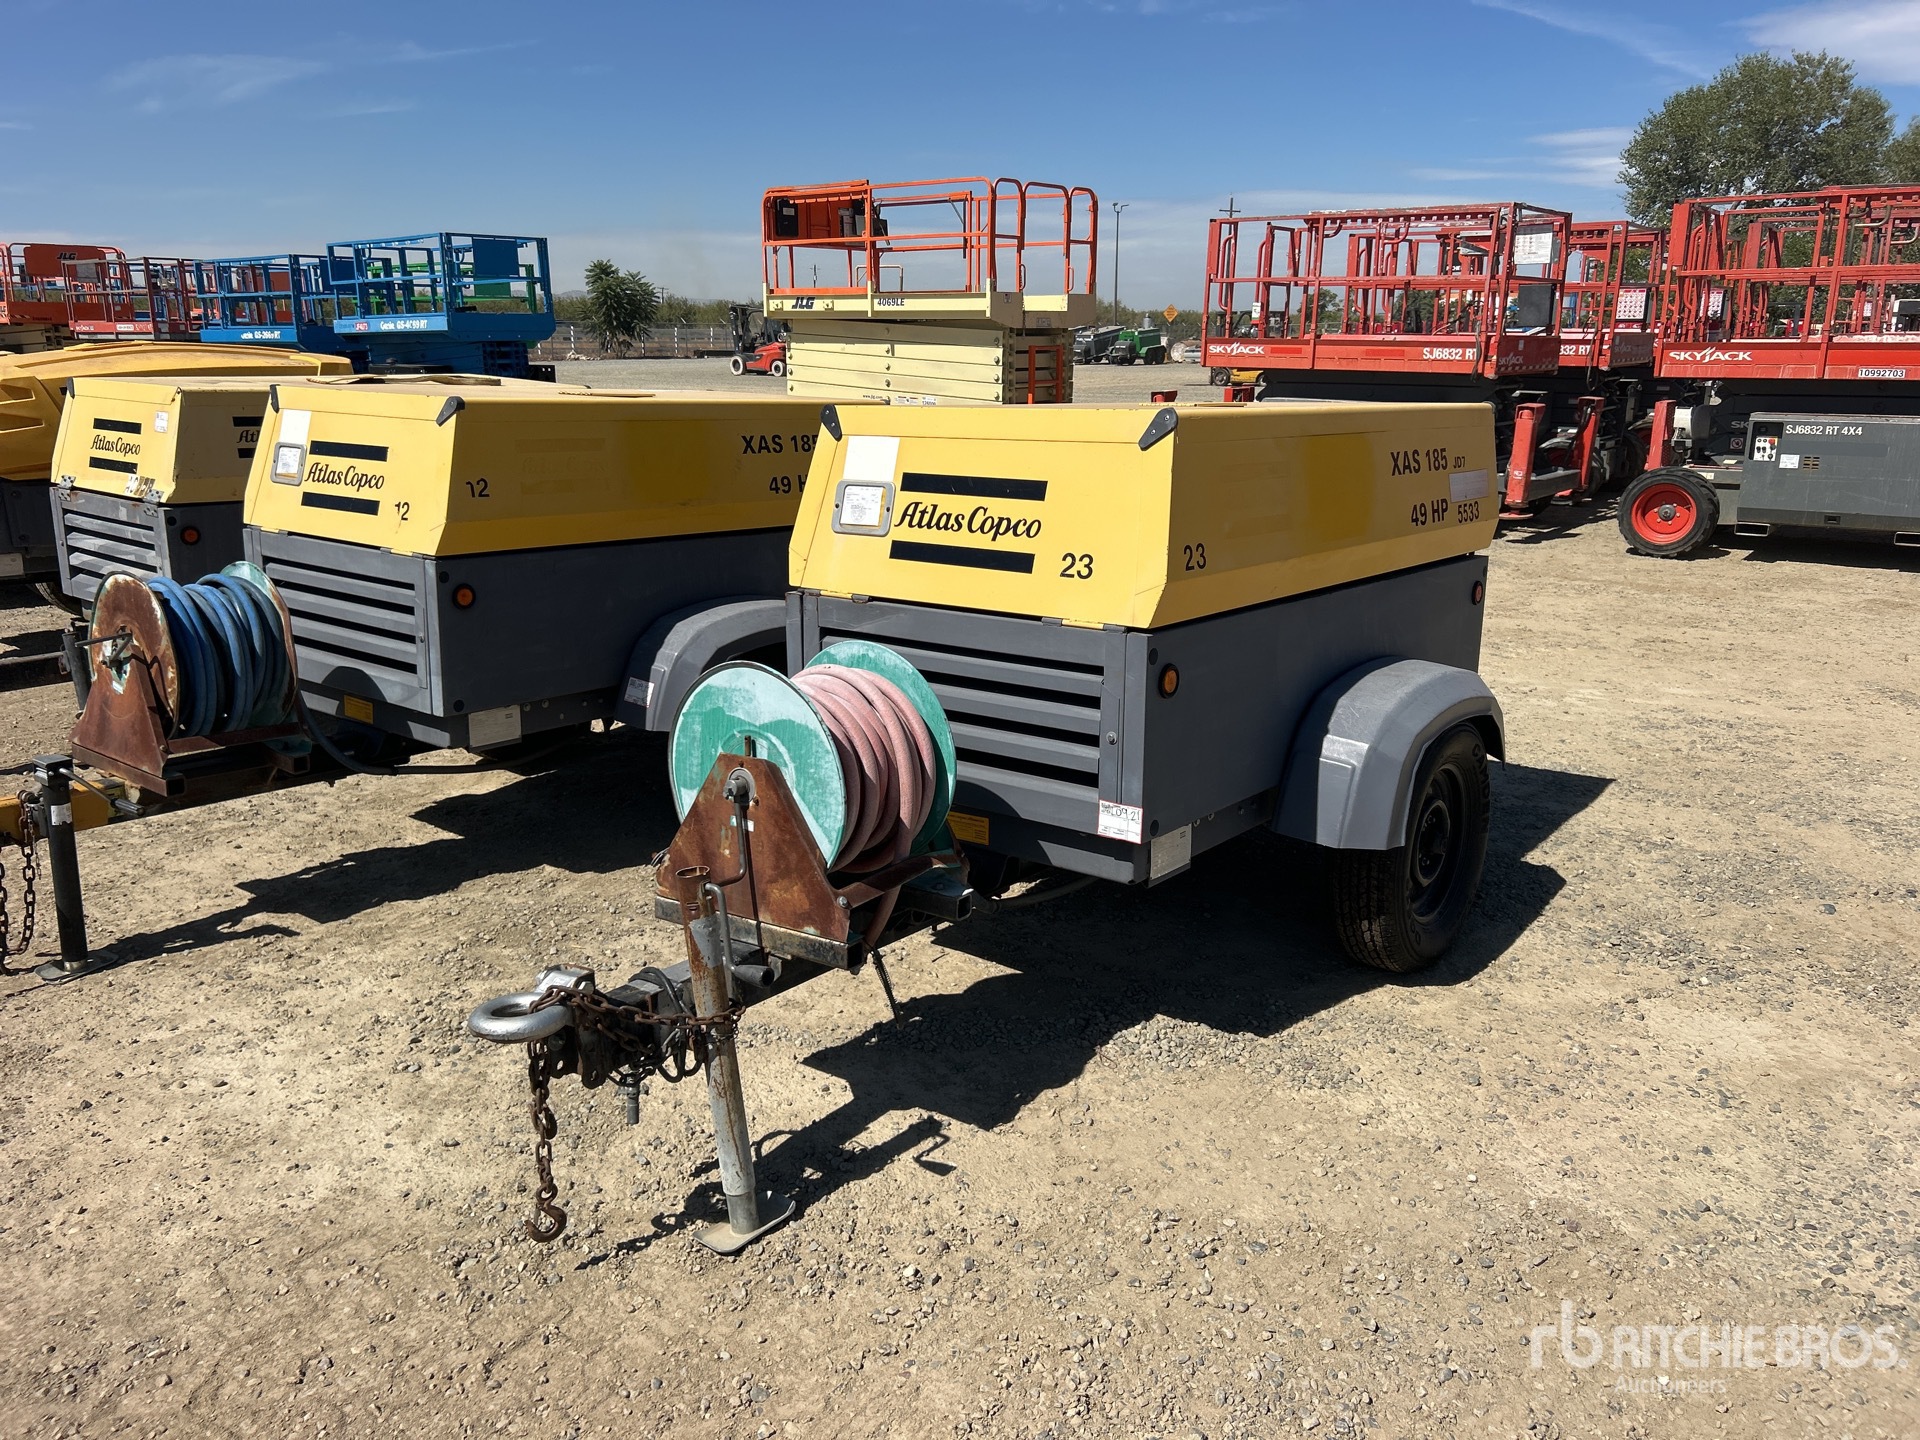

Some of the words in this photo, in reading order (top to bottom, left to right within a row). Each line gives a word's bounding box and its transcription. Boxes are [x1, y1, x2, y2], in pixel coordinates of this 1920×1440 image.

[791, 296, 816, 310] JLG
[877, 298, 905, 307] 4069LE
[1208, 342, 1264, 356] SKYJACK
[1423, 347, 1462, 360] SJ6832
[1668, 346, 1753, 363] SKYJACK
[1498, 352, 1524, 366] SKYJACK
[1858, 369, 1905, 378] 10992703
[236, 429, 260, 443] Atl
[1785, 424, 1823, 435] SJ6832
[1825, 426, 1840, 436] RT
[1841, 426, 1863, 436] 4X4
[90, 434, 116, 452] Atlas
[115, 437, 141, 457] Copco
[741, 434, 784, 454] XAS
[1390, 448, 1421, 476] XAS
[1425, 447, 1448, 472] 185
[1453, 456, 1466, 469] JD7
[304, 462, 344, 486] Atlas
[343, 465, 385, 492] Copco
[769, 475, 792, 494] 49
[465, 477, 490, 498] 12
[394, 501, 410, 521] 12
[1410, 502, 1428, 527] 49
[1431, 498, 1449, 523] HP
[1457, 500, 1480, 524] 5533
[894, 501, 965, 532] Atlas
[967, 505, 1042, 542] Copco
[1059, 552, 1094, 580] 23
[1183, 542, 1207, 571] 23
